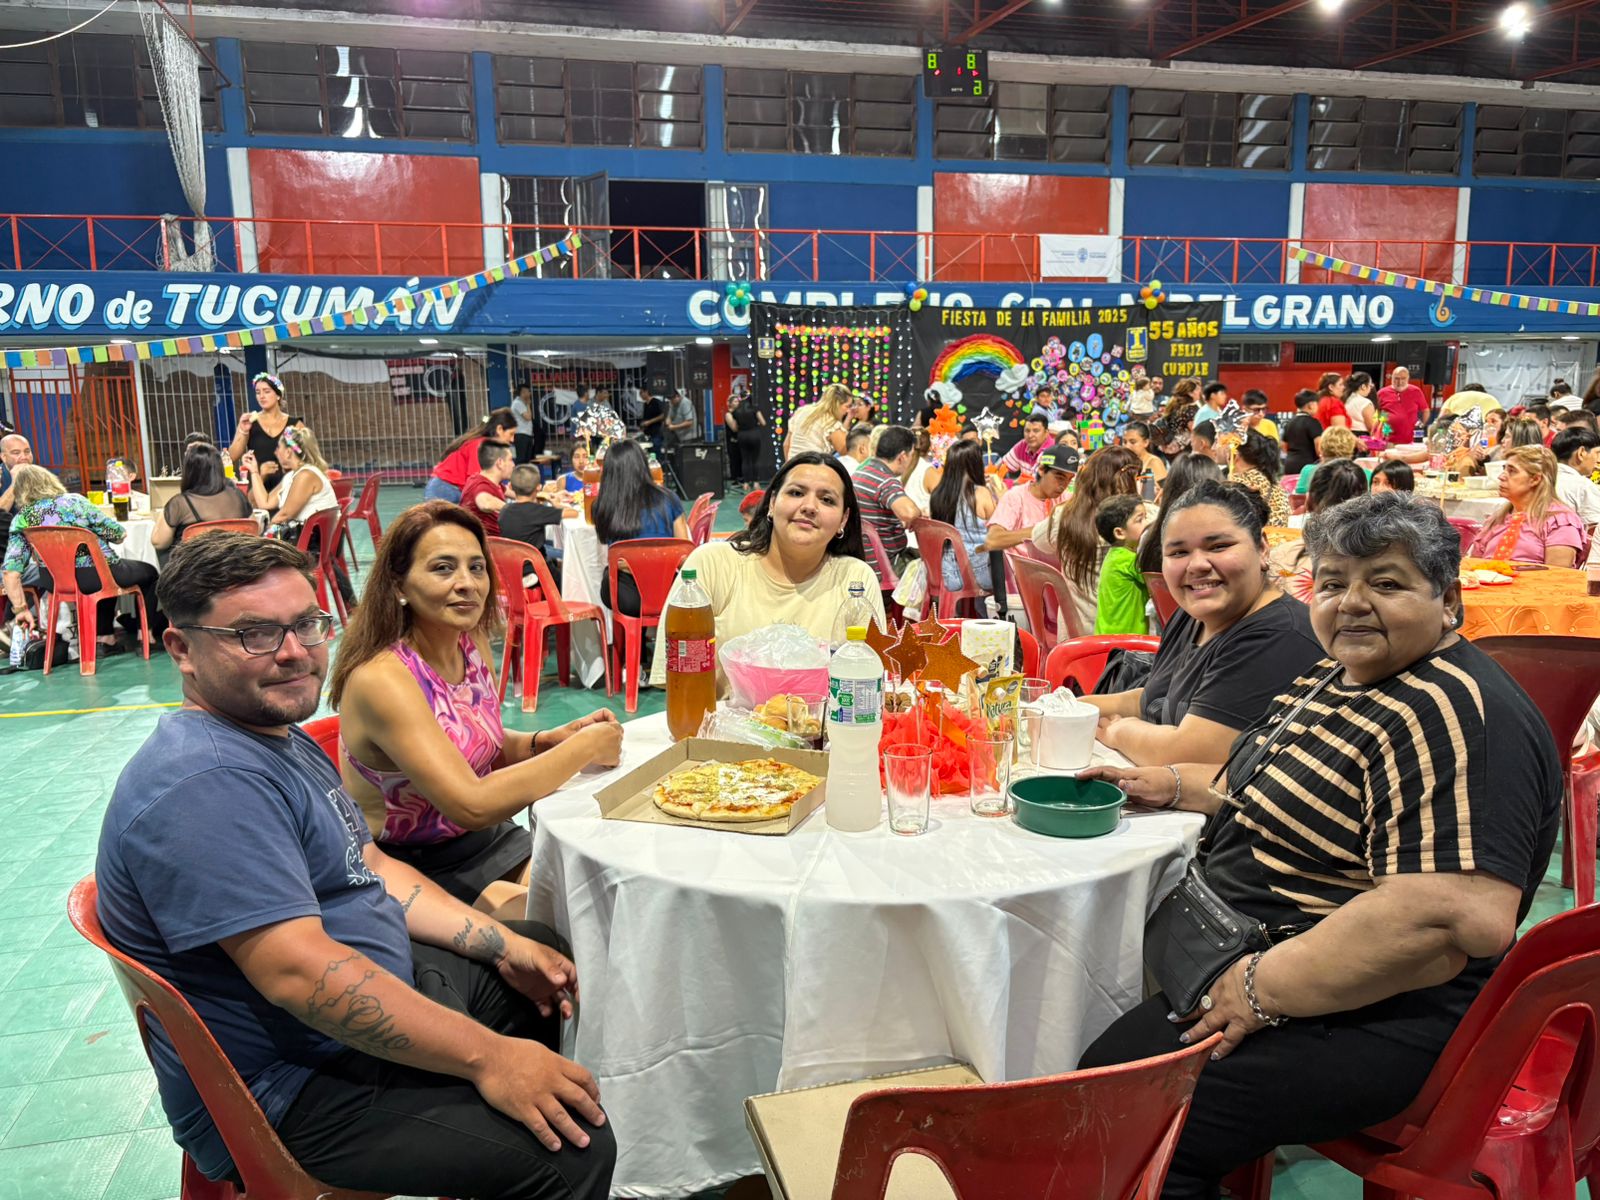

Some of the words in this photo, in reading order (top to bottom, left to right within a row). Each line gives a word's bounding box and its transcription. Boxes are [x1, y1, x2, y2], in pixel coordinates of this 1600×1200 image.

[928, 53, 937, 69] 8
[967, 54, 976, 69] 8
[105, 288, 152, 325] de
[164, 277, 467, 326] TUCUMÁN
[1168, 293, 1395, 328] LGRANO
[941, 309, 987, 327] FIESTA
[996, 310, 1012, 327] DE
[1020, 310, 1035, 327] LA
[1042, 309, 1091, 327] FAMILIA
[1098, 308, 1128, 324] 2025
[1148, 320, 1174, 340] 55
[1176, 317, 1219, 338] AÑOS
[1170, 343, 1204, 358] FELIZ
[1162, 362, 1210, 377] CUMPLE
